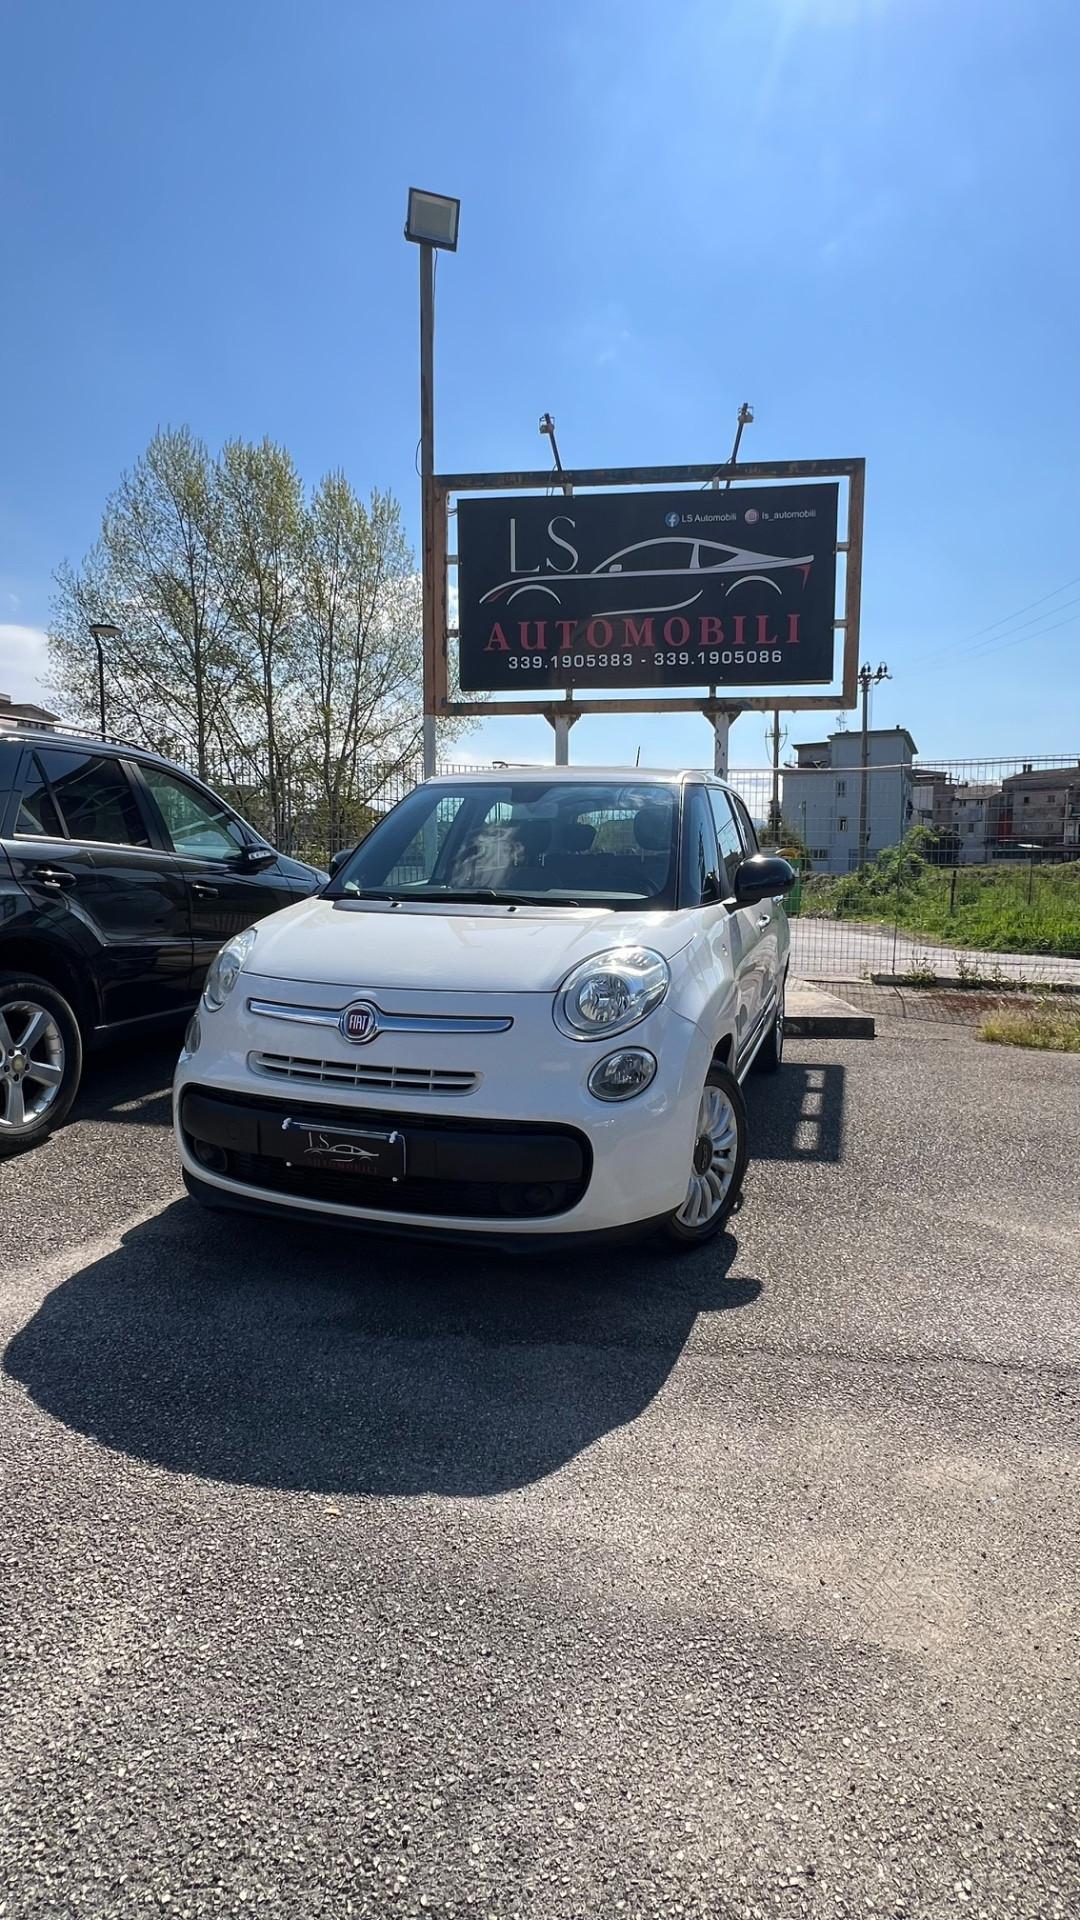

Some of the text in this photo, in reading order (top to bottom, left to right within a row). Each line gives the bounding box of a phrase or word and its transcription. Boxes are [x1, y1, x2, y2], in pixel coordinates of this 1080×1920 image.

[682, 514, 693, 523] LS
[694, 512, 737, 522] Automobili
[762, 509, 817, 521] ls_automobili
[510, 515, 578, 573] LS
[483, 614, 800, 651] AUTOMOBILI
[508, 653, 633, 669] 339.1905383
[653, 650, 782, 666] 339.1905086
[349, 1014, 368, 1030] FIAT
